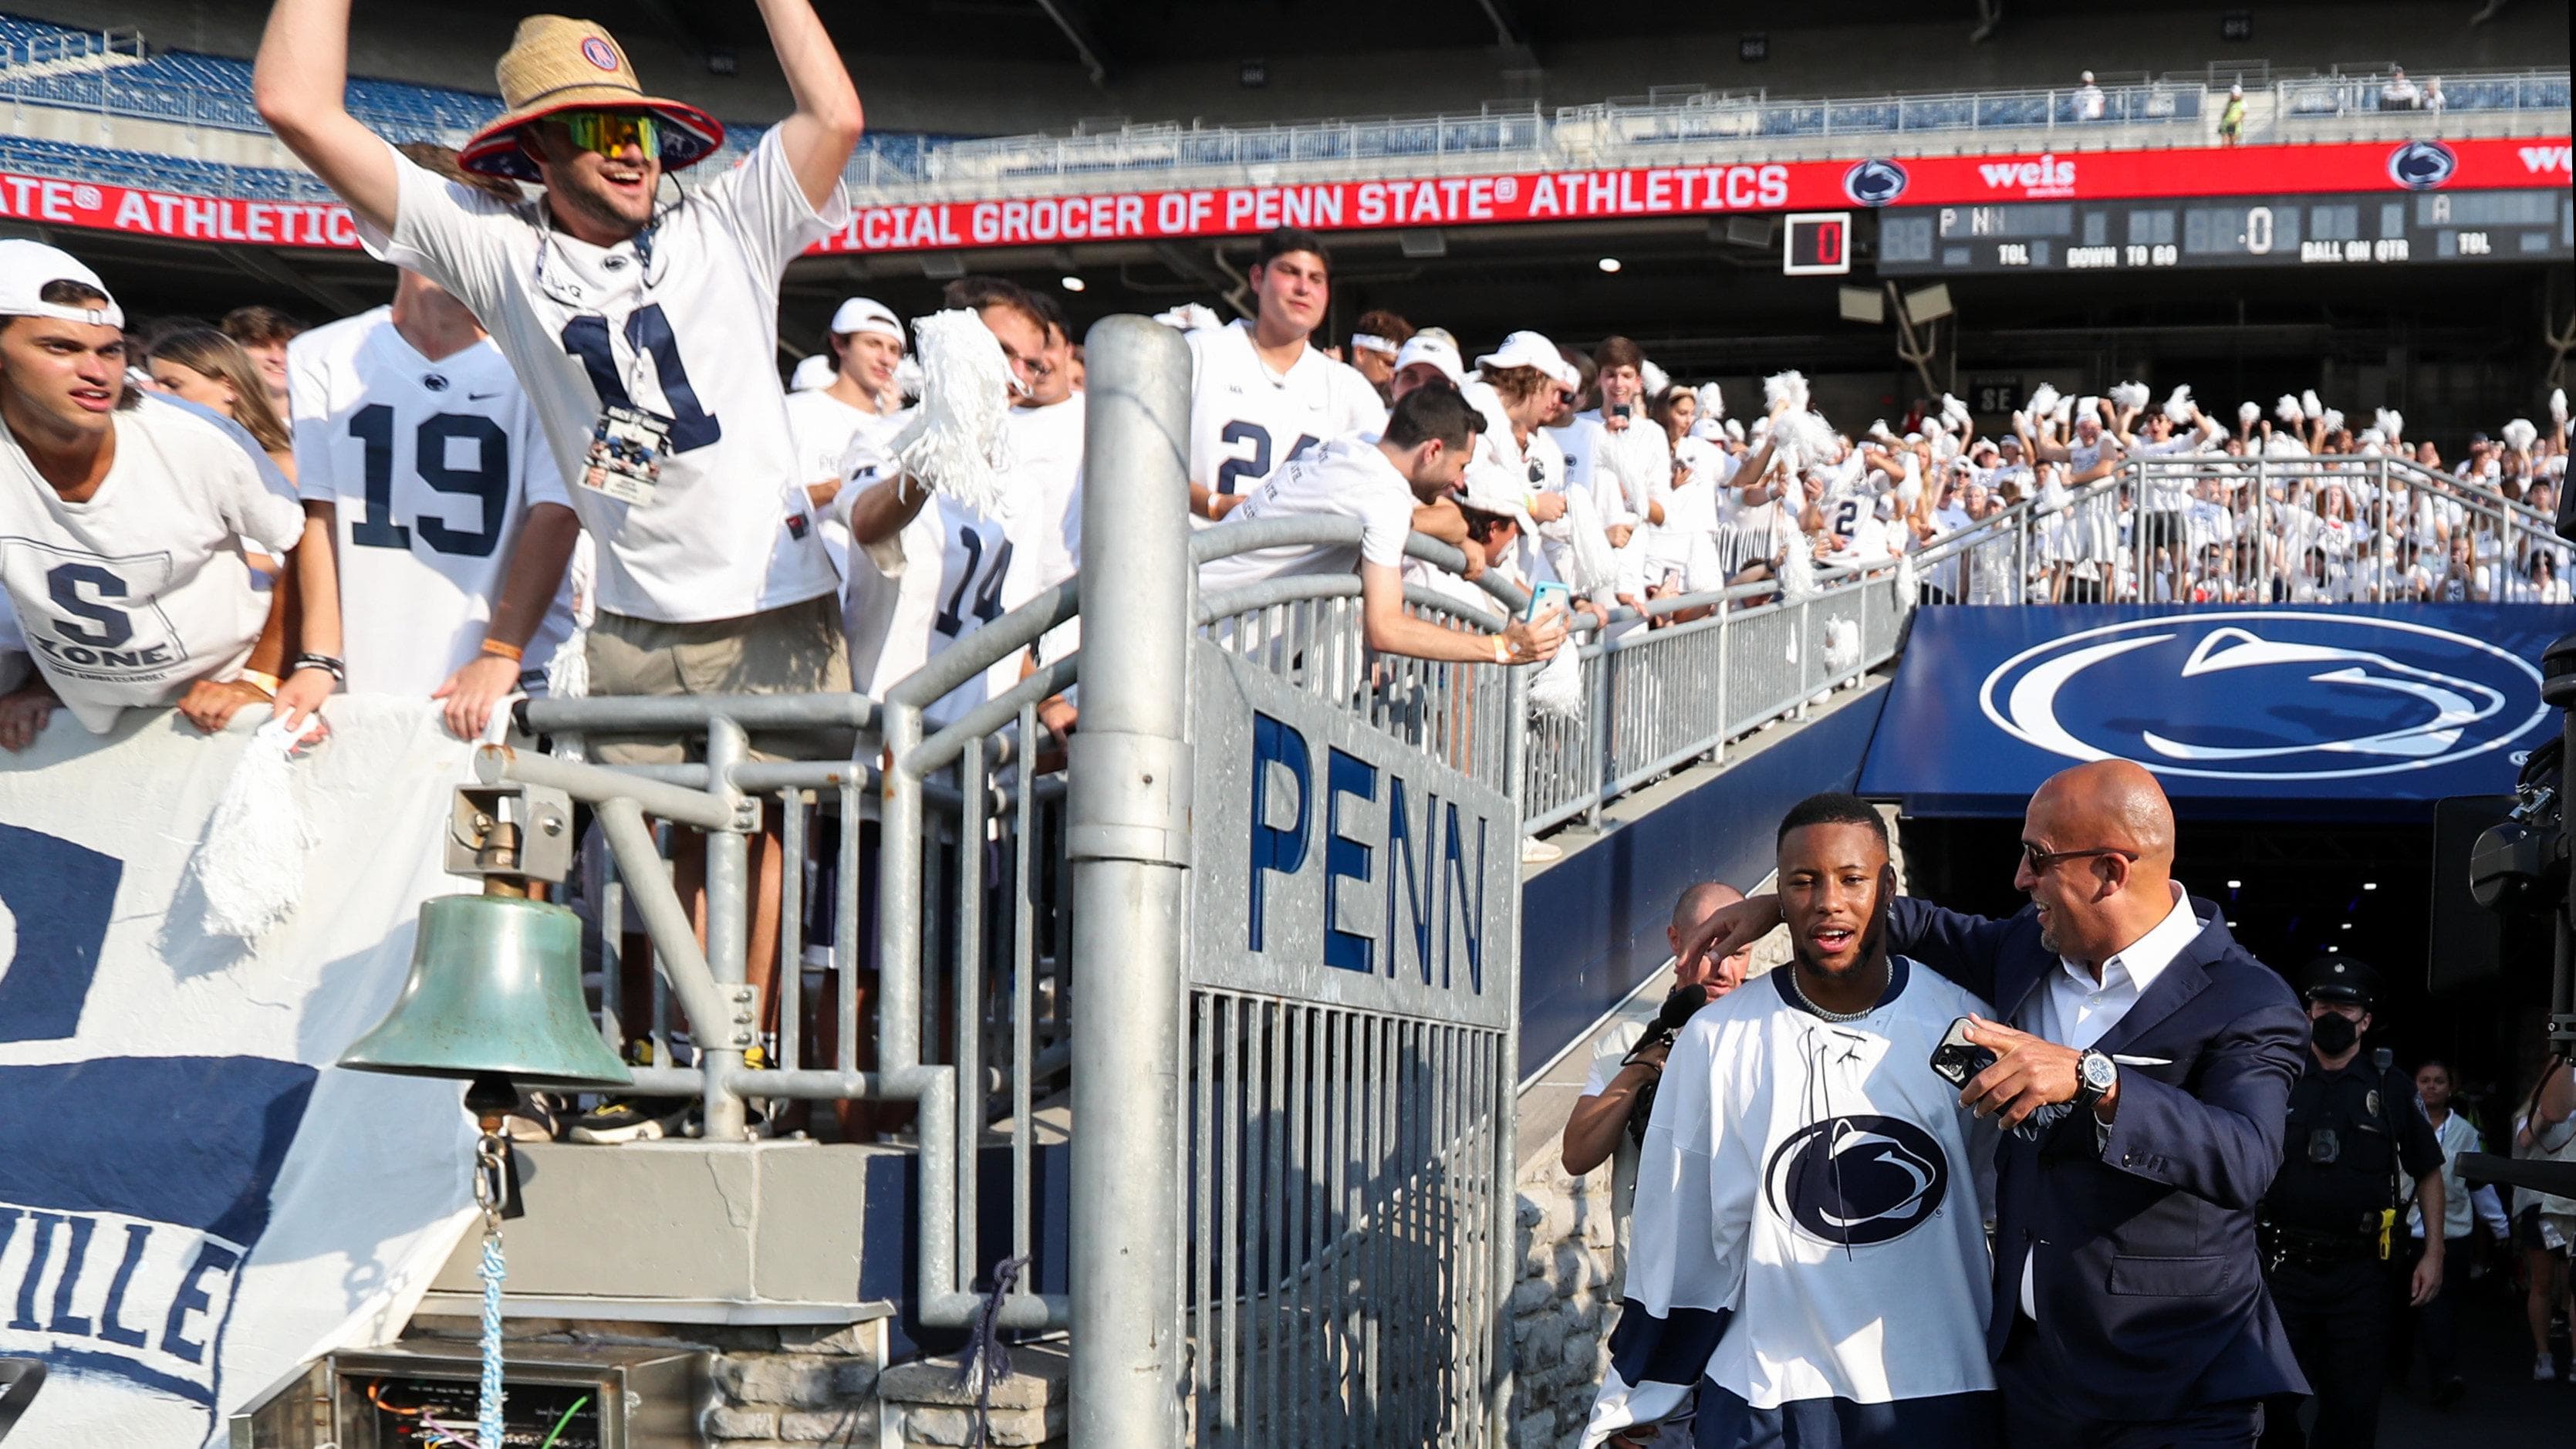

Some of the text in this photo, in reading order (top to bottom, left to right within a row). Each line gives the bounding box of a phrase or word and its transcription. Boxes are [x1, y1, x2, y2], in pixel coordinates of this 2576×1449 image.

[1978, 154, 2076, 188] weis
[973, 196, 1144, 242] GROCER
[1157, 191, 1214, 234] OF
[1226, 184, 1344, 231] PENN
[1528, 164, 1789, 217] ATHLETICS
[1816, 221, 1841, 264] 0
[1998, 244, 2030, 265] TOL
[2067, 245, 2118, 268] DOWN
[2125, 245, 2178, 267] TO GO
[2301, 240, 2372, 263] BALL ON
[2374, 239, 2409, 264] QTR
[2458, 232, 2492, 255] TOL
[349, 404, 511, 557] 19
[1834, 502, 1859, 536] 2
[935, 525, 1014, 638] 14
[47, 562, 134, 649] S
[1247, 708, 1487, 996] PENN
